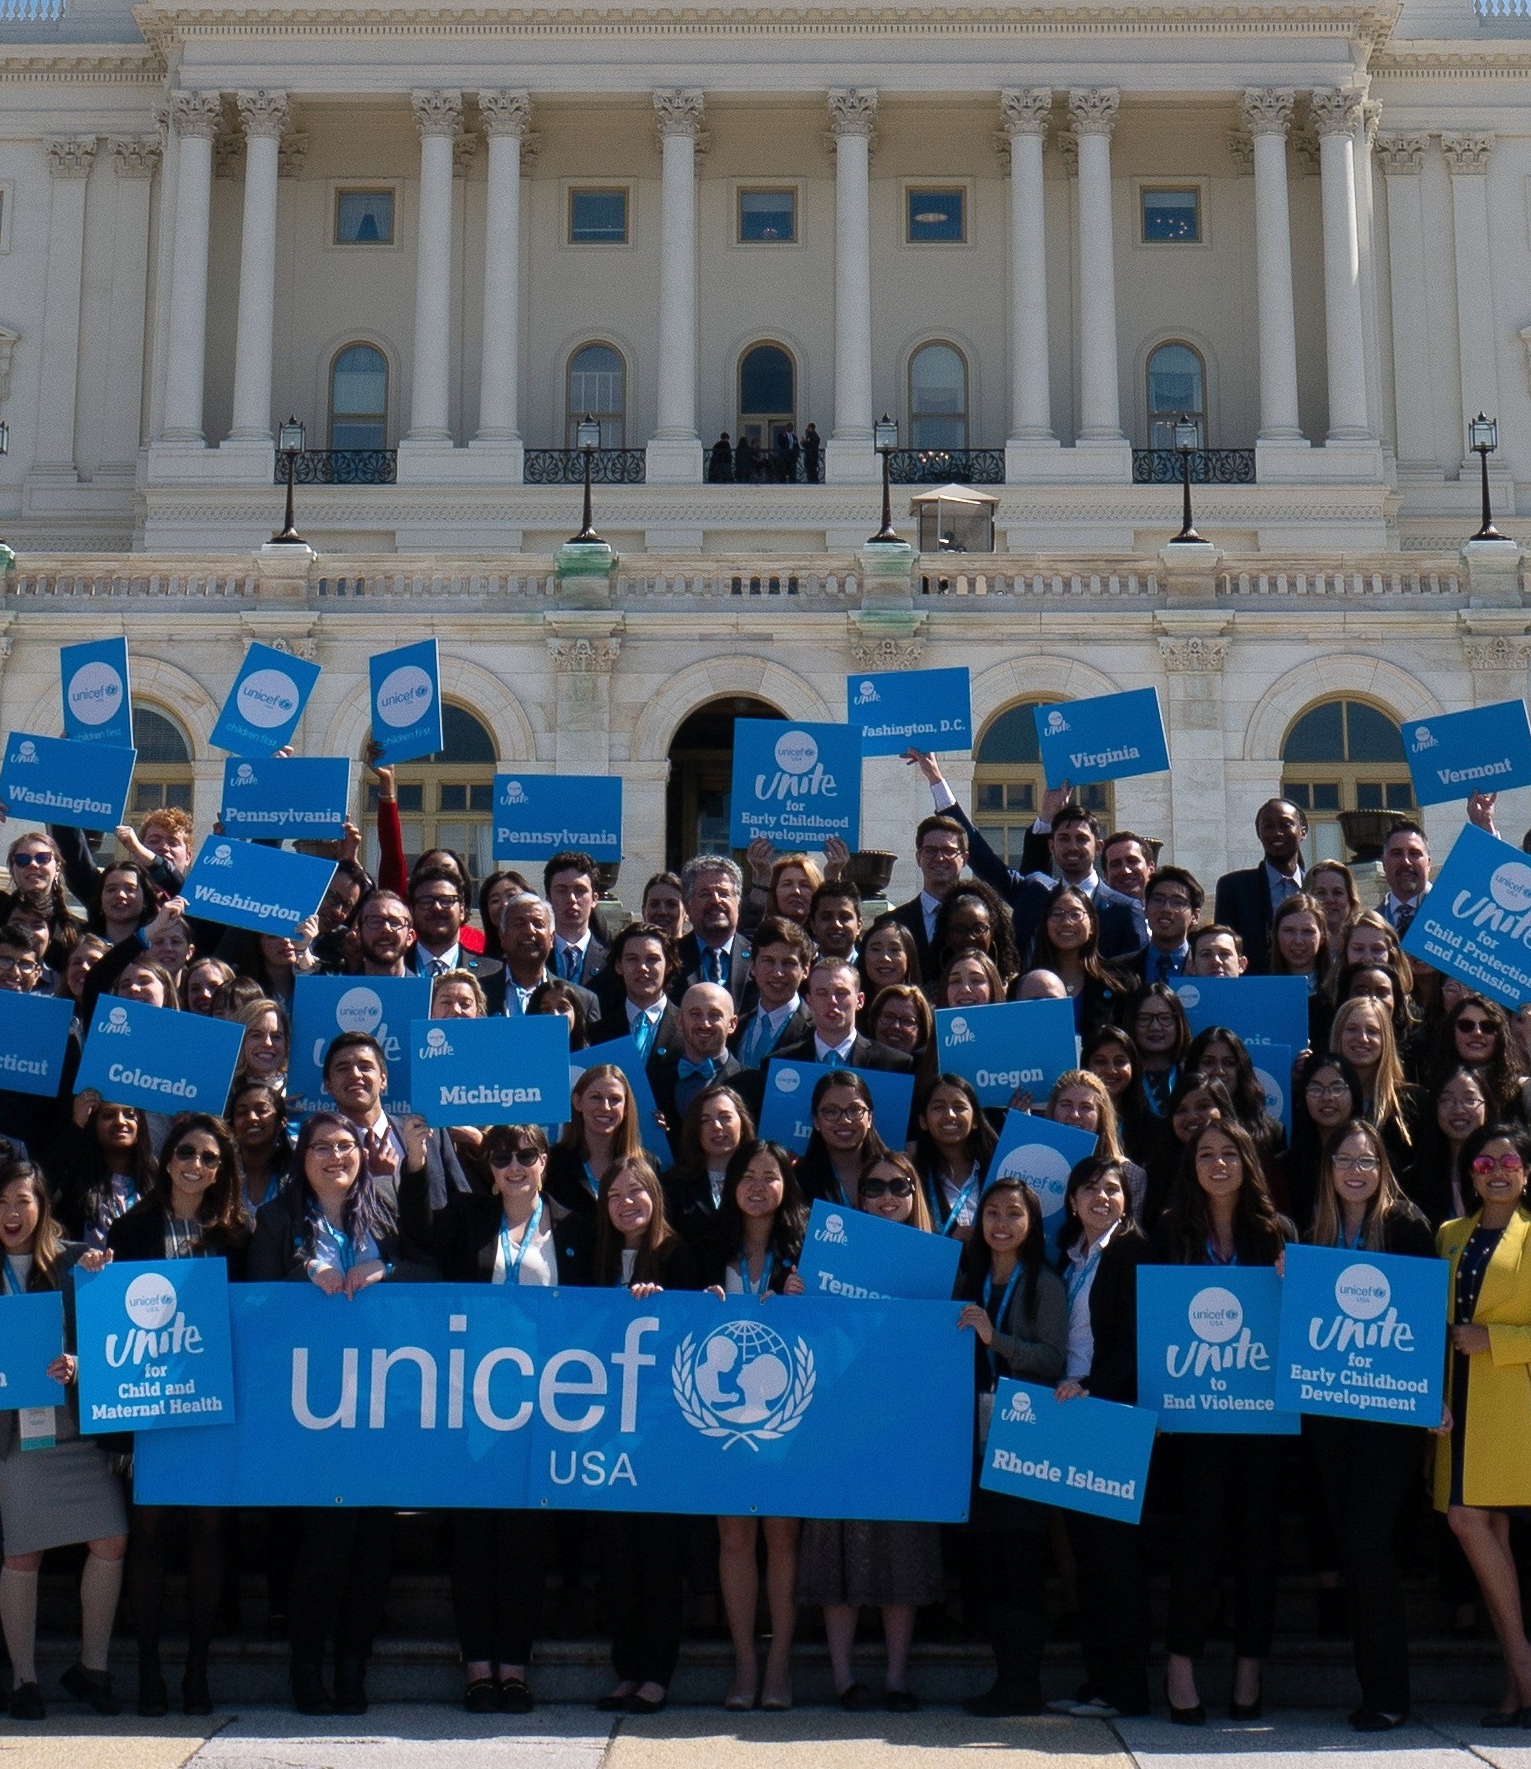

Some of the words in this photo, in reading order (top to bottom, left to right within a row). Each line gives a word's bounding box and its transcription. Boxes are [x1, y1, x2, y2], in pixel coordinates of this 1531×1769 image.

[72, 685, 105, 702] unicef
[243, 687, 280, 706] unicef
[382, 689, 414, 707] unicef
[226, 723, 260, 741] children
[941, 719, 966, 732] D.C.
[778, 748, 804, 756] unicef
[1070, 744, 1140, 768] Virginia
[1437, 758, 1513, 785] Vermont
[8, 784, 112, 815] Washington
[786, 800, 806, 812] for
[225, 808, 341, 826] Pennsylvania
[742, 812, 776, 828] Early
[780, 812, 849, 828] Childhood
[498, 827, 618, 848] Pennsylvania
[1494, 874, 1526, 896] unicef
[194, 884, 301, 922] Washington
[1424, 919, 1460, 948] Child
[1476, 930, 1500, 949] for
[1424, 939, 1452, 962] and
[1452, 952, 1521, 1000] Inclusion
[108, 1063, 198, 1098] Colorado
[976, 1068, 1044, 1090] Oregon
[439, 1084, 541, 1108] Michigan
[129, 1294, 160, 1306] unicef
[1340, 1286, 1372, 1297] unicef
[1192, 1308, 1226, 1320] unicef
[1348, 1352, 1374, 1368] for
[144, 1364, 168, 1378] for
[290, 1316, 660, 1433] unicef
[1290, 1364, 1336, 1386] Early
[1340, 1370, 1428, 1394] Childhood
[118, 1381, 160, 1400] Child
[164, 1379, 195, 1396] and
[1210, 1378, 1228, 1392] to
[91, 1401, 166, 1420] Maternal
[170, 1396, 223, 1414] Health
[1164, 1394, 1196, 1410] End
[1200, 1394, 1275, 1412] Violence
[1301, 1384, 1416, 1411] Development
[549, 1450, 638, 1487] USA
[992, 1448, 1062, 1482] Rhode
[1066, 1466, 1136, 1500] Island
